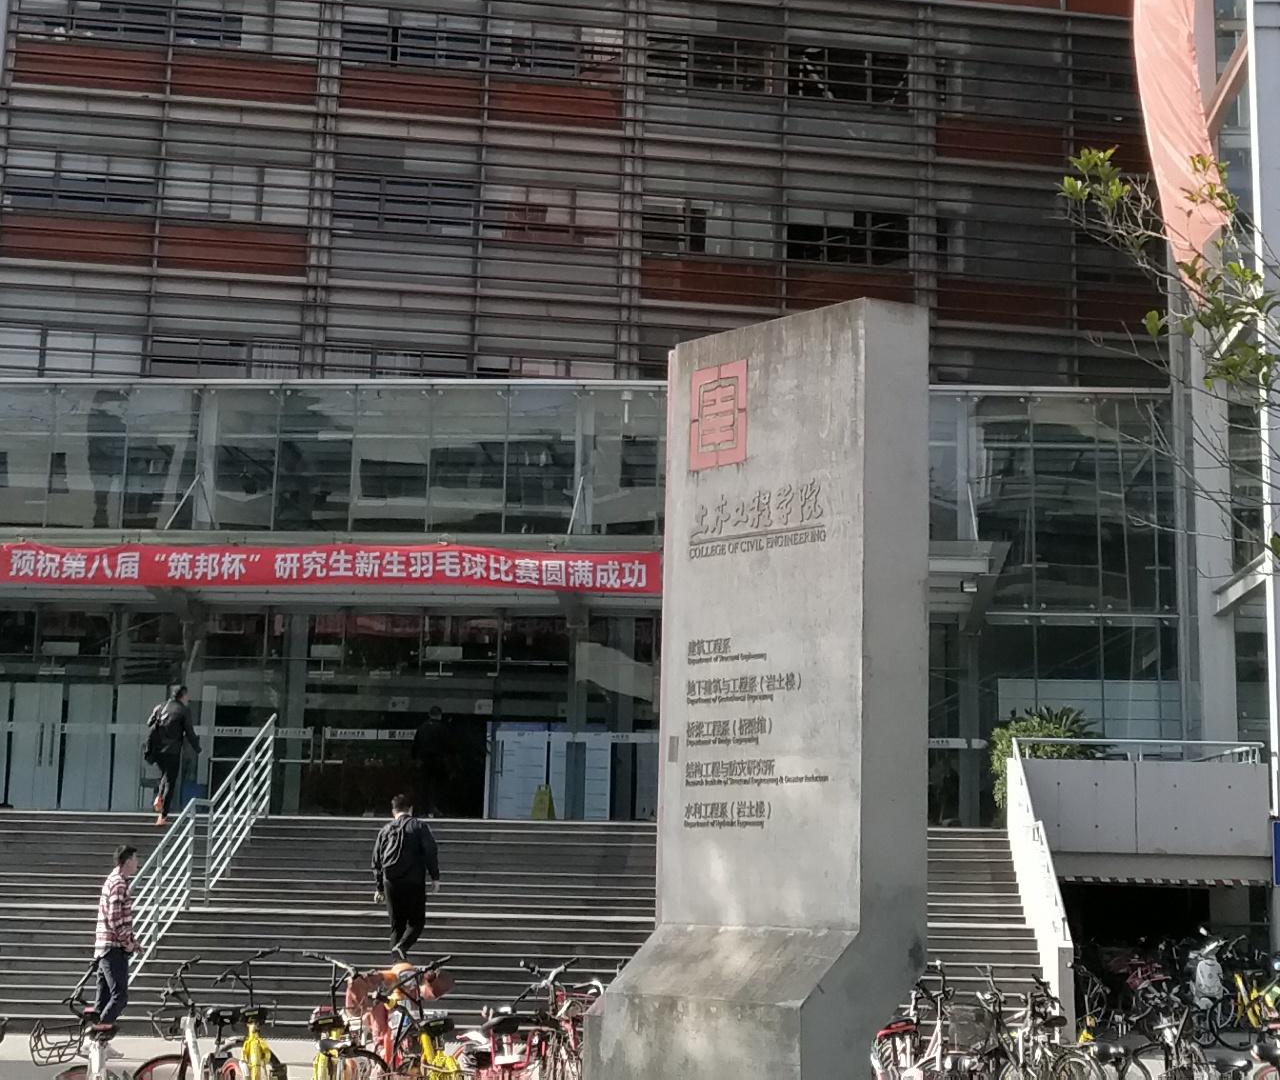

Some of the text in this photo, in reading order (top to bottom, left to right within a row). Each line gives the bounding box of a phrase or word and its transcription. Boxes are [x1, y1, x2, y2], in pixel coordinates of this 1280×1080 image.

[690, 478, 824, 538] 土木工程学院
[689, 530, 826, 560] COLLEGE OF CIVIL ENGINEERING
